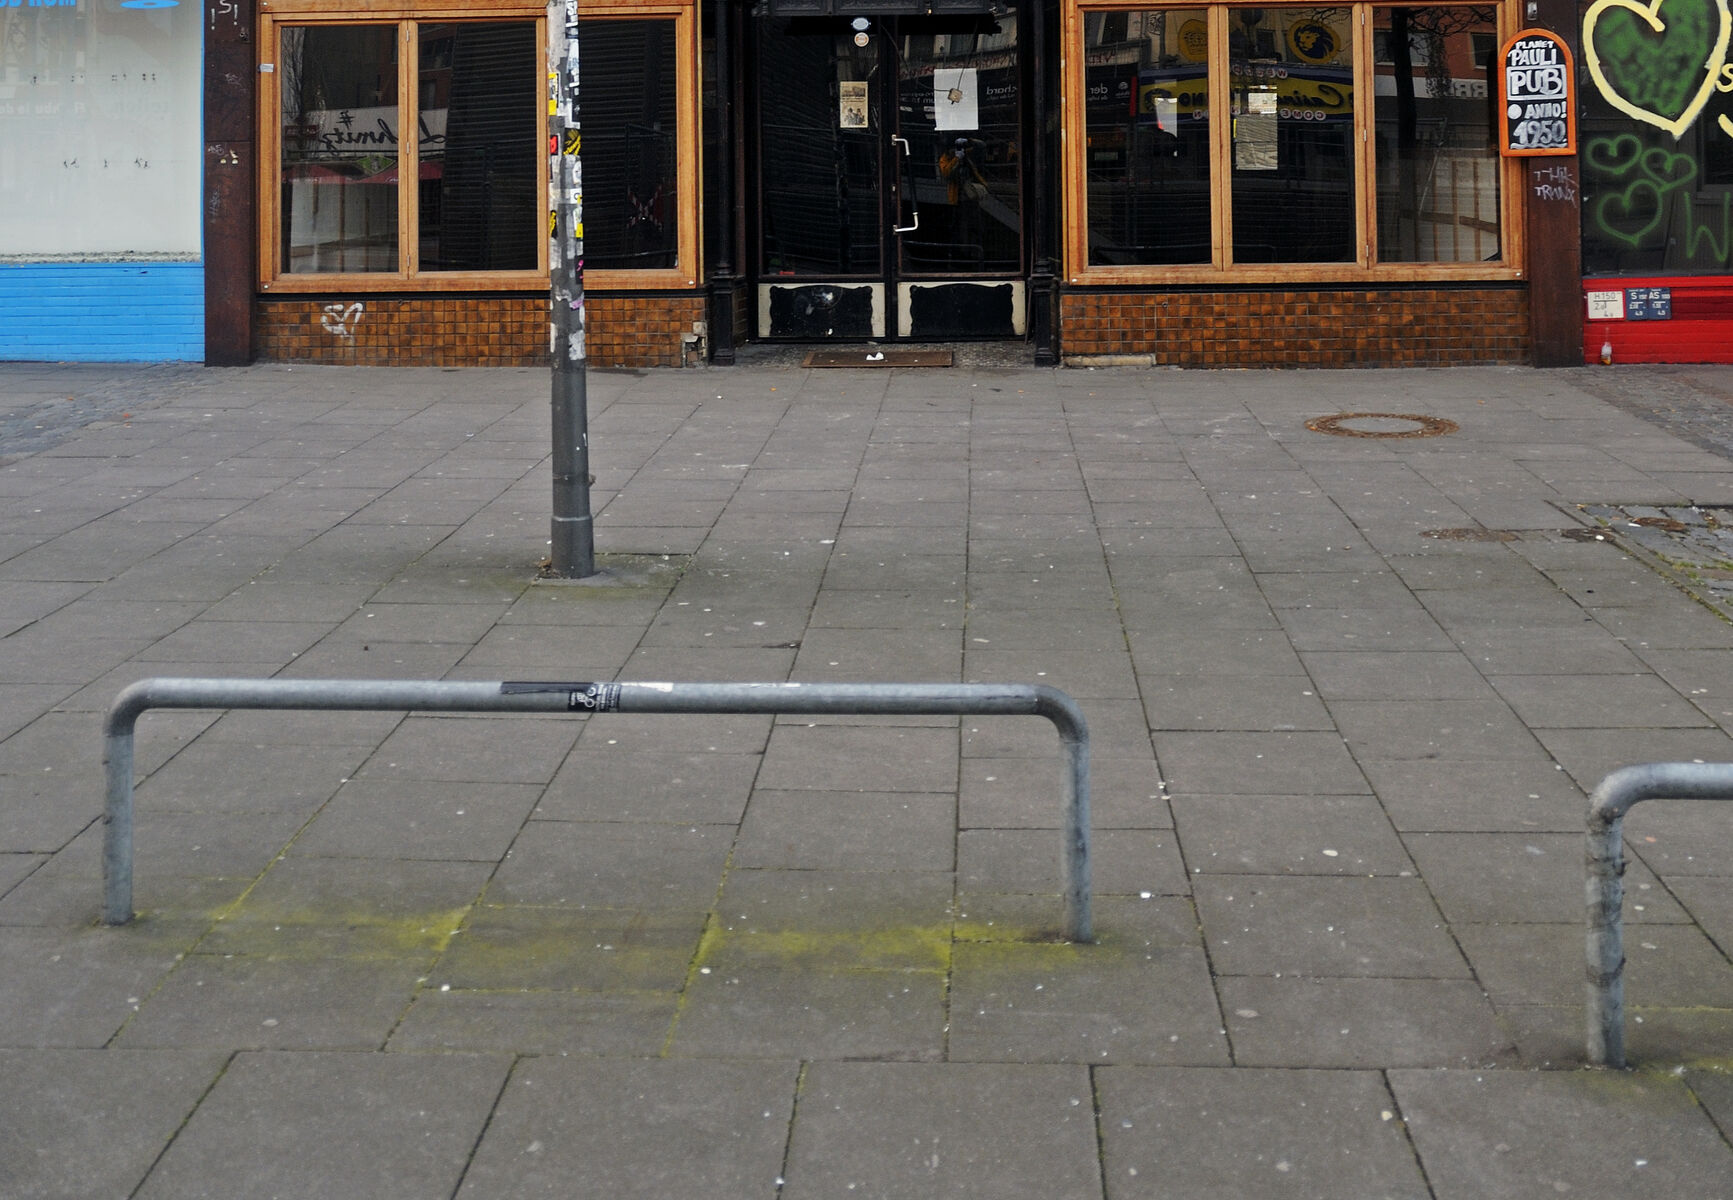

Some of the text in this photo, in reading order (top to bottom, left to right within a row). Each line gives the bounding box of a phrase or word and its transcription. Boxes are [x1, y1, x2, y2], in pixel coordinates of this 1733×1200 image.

[1515, 40, 1554, 50] PLANET
[1508, 48, 1556, 66] PAULI
[1510, 68, 1563, 96] PUB
